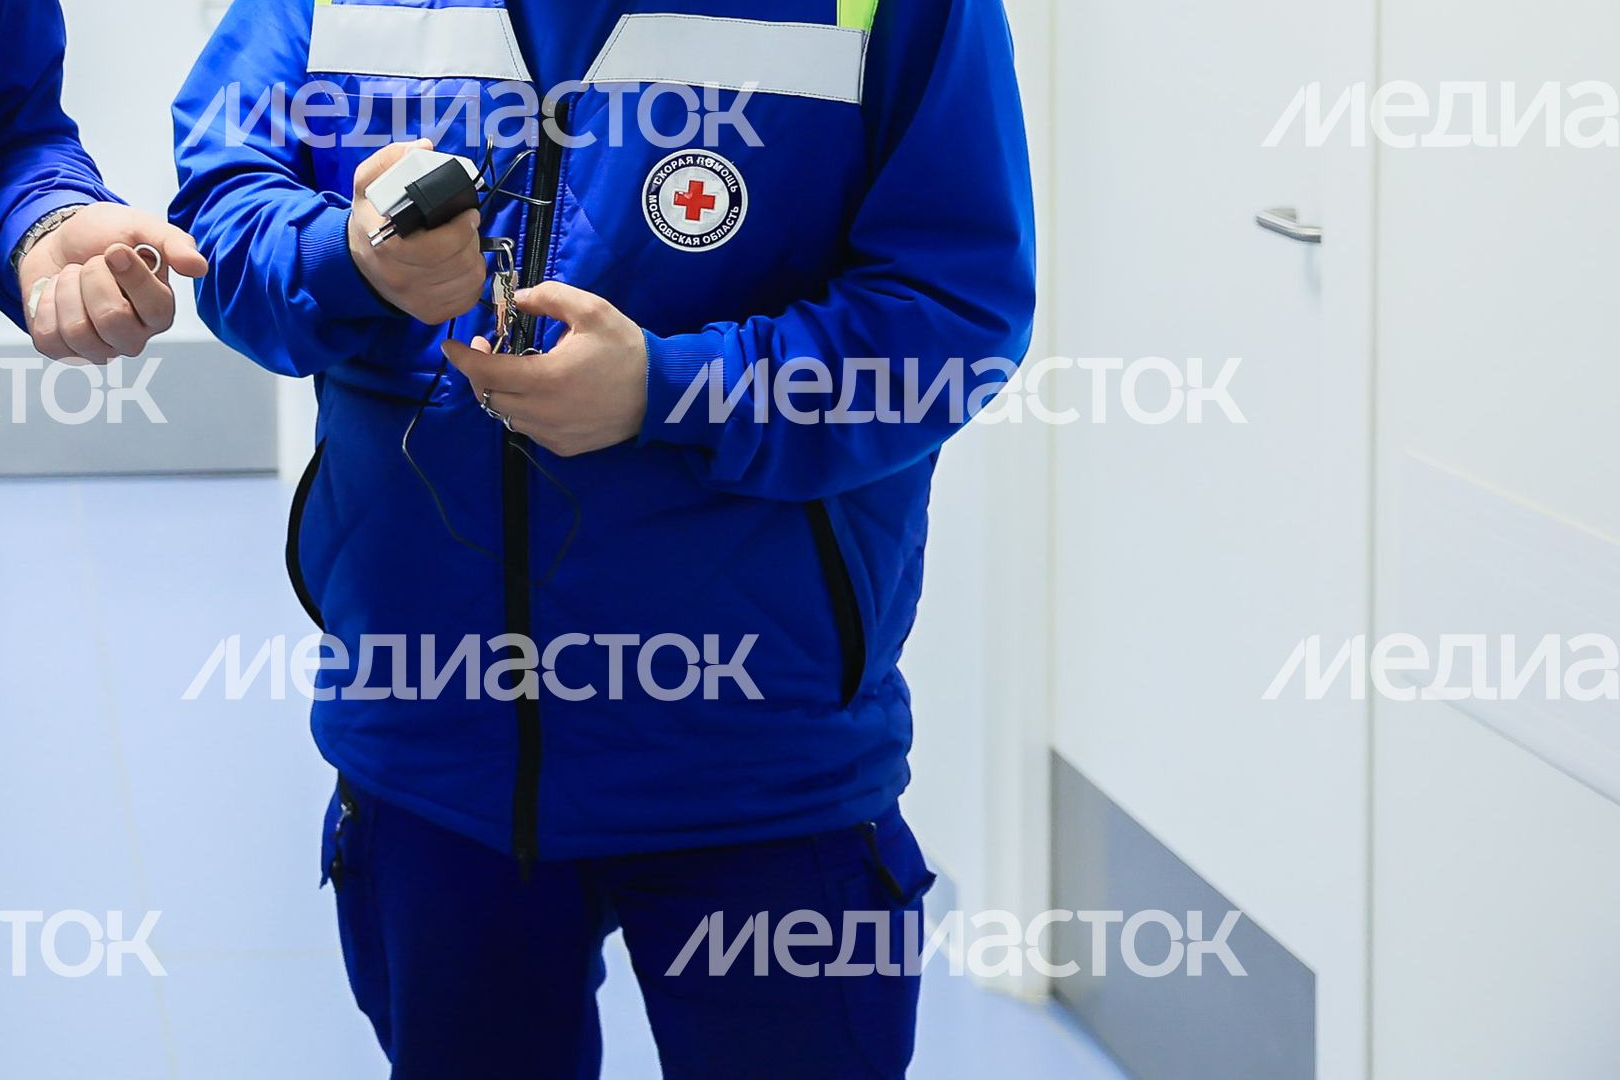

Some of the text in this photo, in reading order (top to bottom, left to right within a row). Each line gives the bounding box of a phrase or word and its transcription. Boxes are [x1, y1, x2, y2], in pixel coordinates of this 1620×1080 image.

[654, 156, 737, 192] СКОРАЯ ПОМОЩЬ
[648, 195, 739, 245] МОСКОВСКАЯ ОБЛАСТЬ
